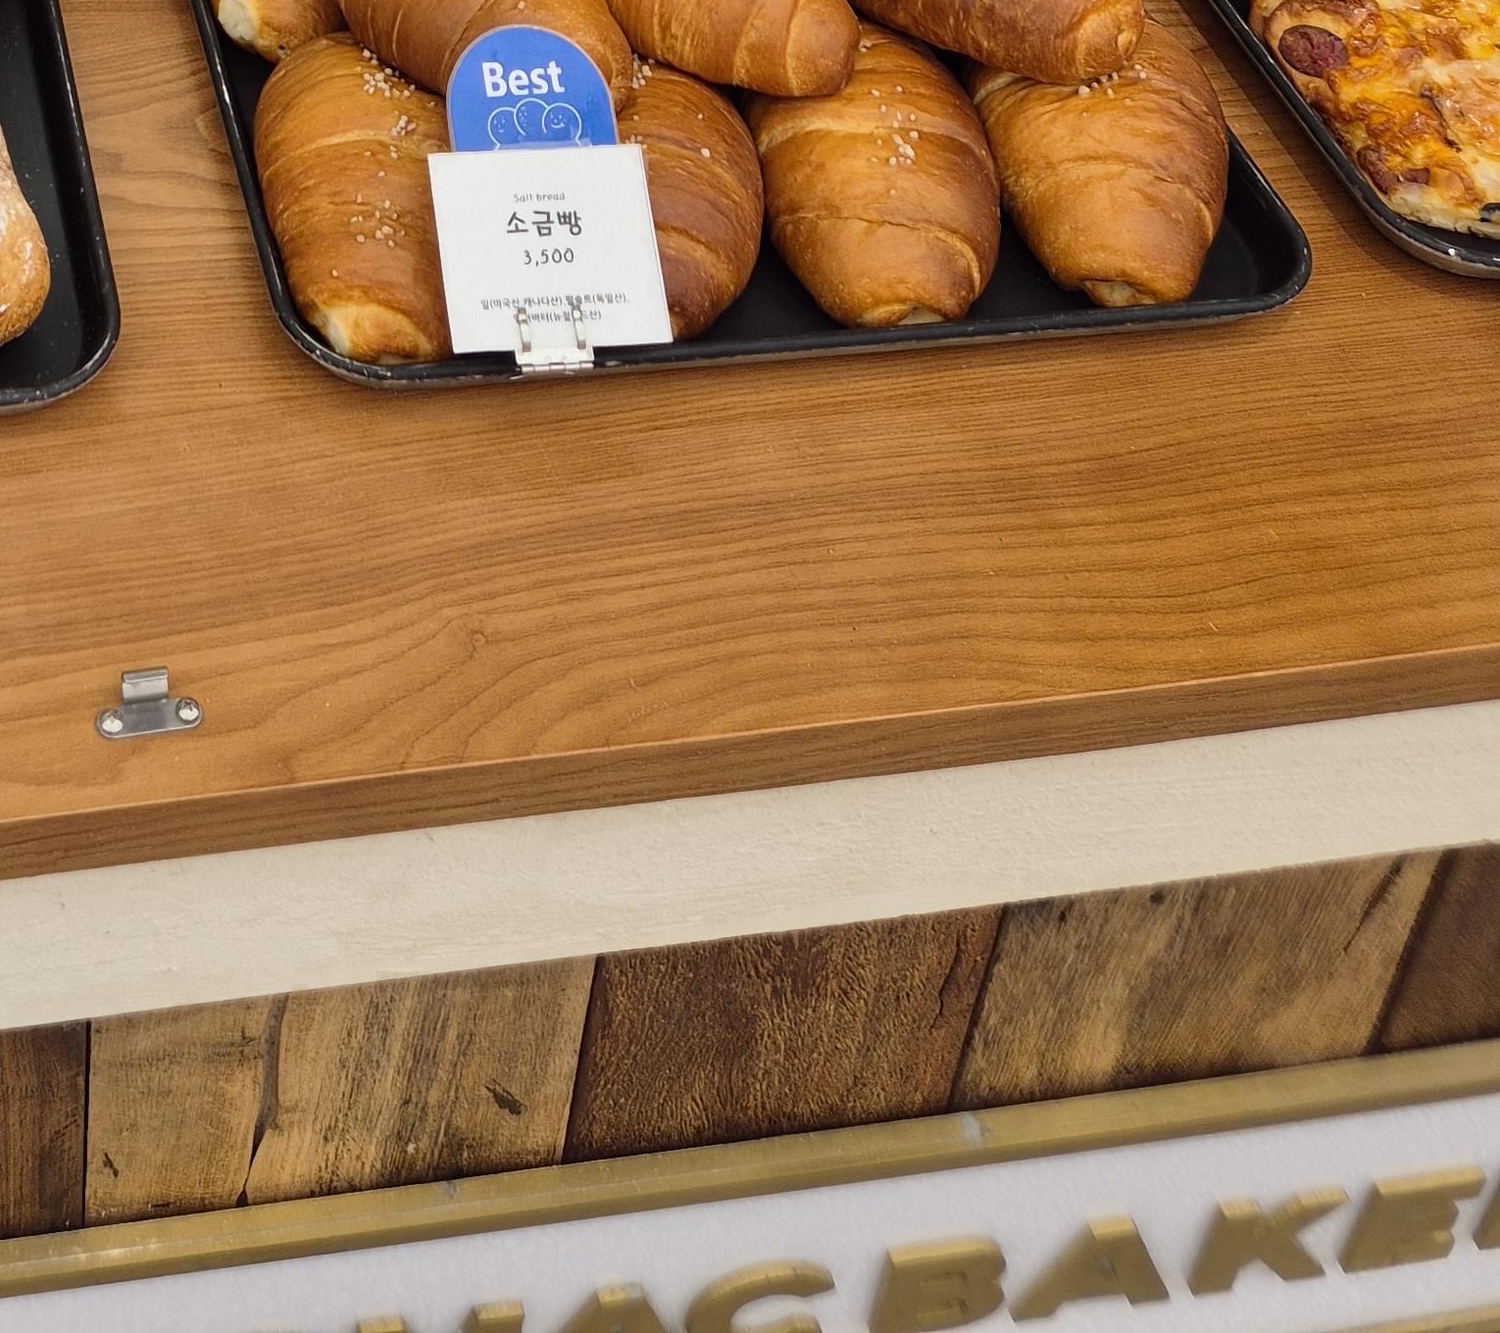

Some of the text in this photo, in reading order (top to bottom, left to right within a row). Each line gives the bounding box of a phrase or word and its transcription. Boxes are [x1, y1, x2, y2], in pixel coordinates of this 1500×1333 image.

[481, 59, 567, 99] Best
[513, 191, 566, 203] Salt bread
[505, 209, 583, 238] 소금빵
[523, 246, 575, 268] 3,500
[867, 1164, 1500, 1333] BAKE
